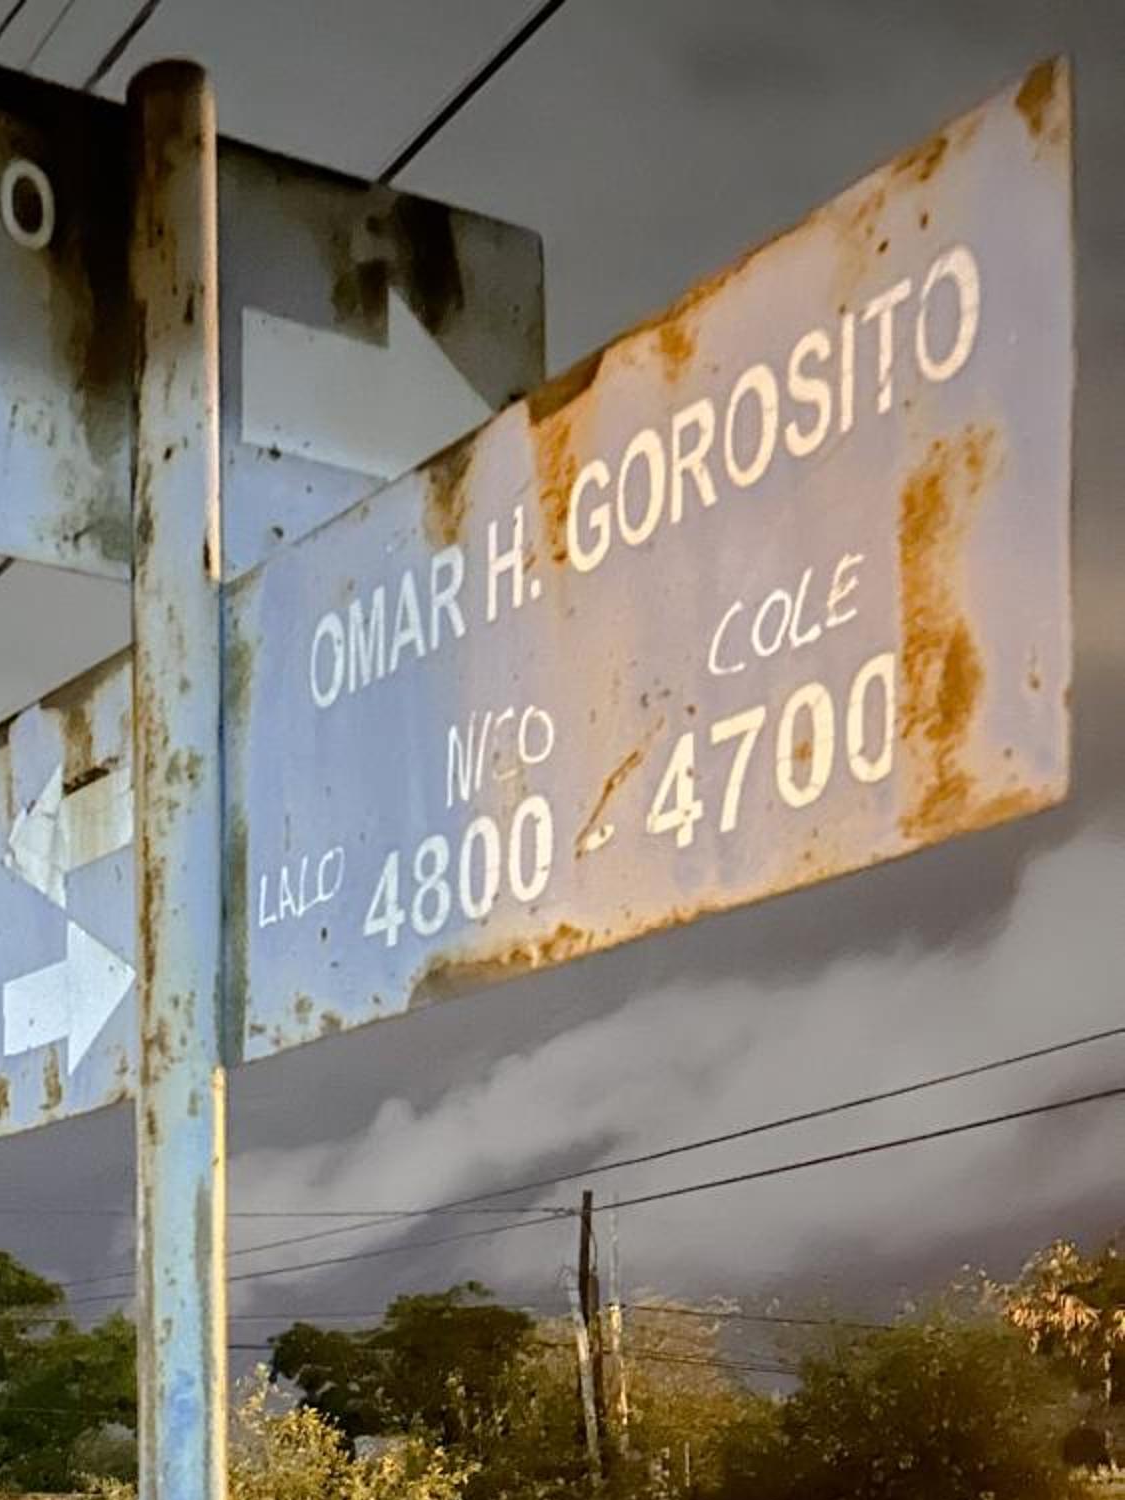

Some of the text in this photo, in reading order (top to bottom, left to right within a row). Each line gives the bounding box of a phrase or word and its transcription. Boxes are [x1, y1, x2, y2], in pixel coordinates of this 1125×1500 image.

[308, 243, 982, 709] OMAR H. GOROSITO
[707, 553, 864, 675] COLE
[258, 845, 345, 928] LALO
[362, 795, 554, 948] 4800
[645, 652, 896, 849] 4700
